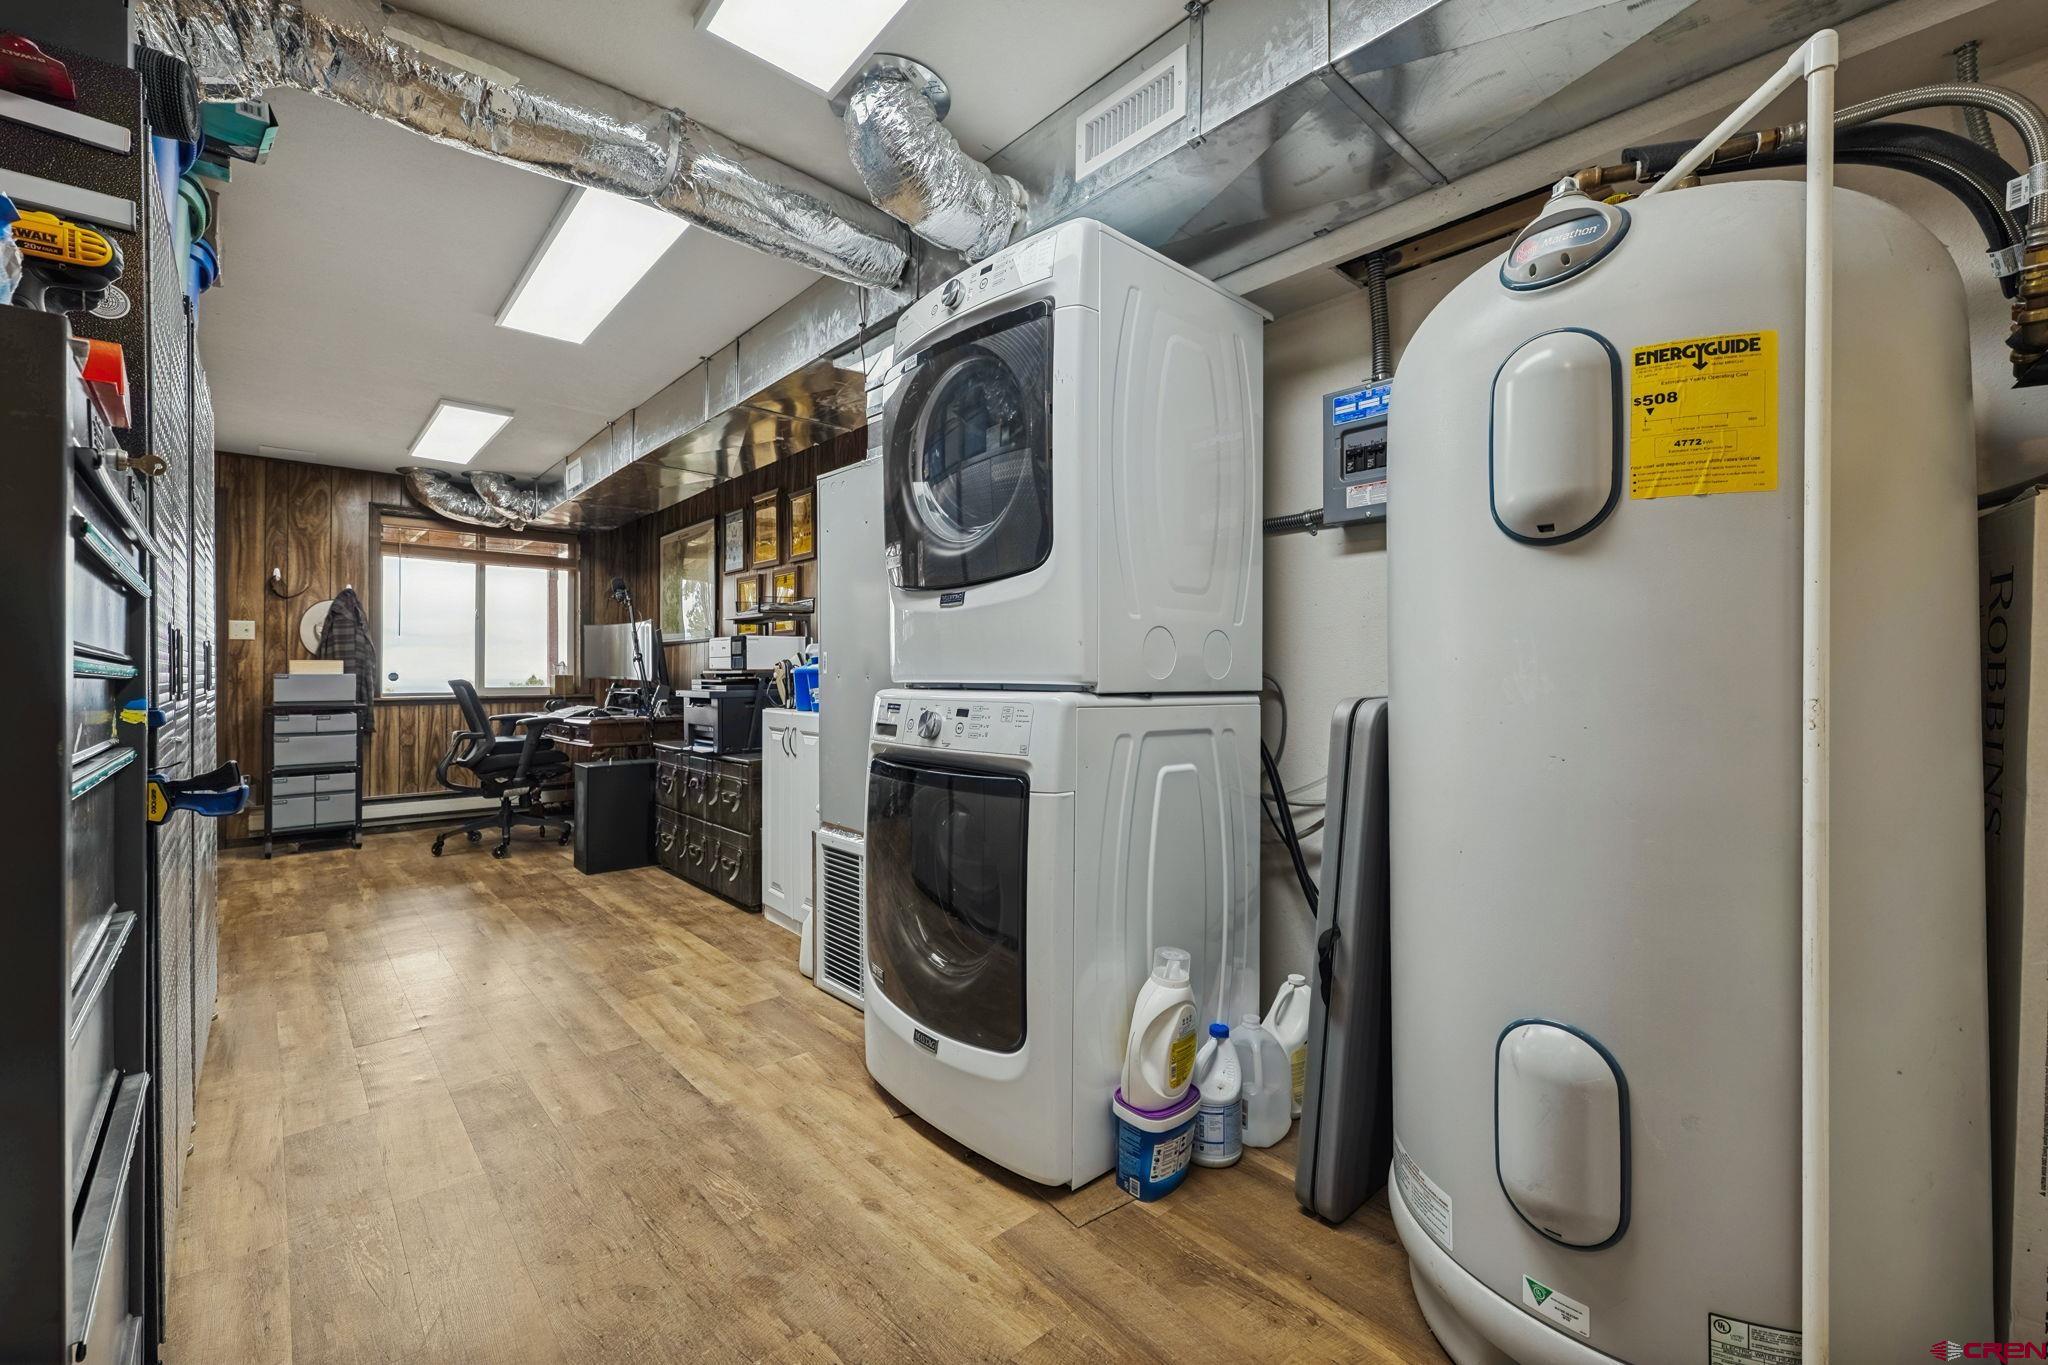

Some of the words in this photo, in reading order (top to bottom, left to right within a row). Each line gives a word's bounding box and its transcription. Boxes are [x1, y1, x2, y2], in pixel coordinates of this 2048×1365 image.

[1542, 225, 1598, 247] Marathon
[1635, 337, 1761, 370] ENERGYGUIDE
[1633, 391, 1678, 407] $508
[1674, 438, 1702, 448] 4772
[1984, 564, 2014, 837] ROBBINS
